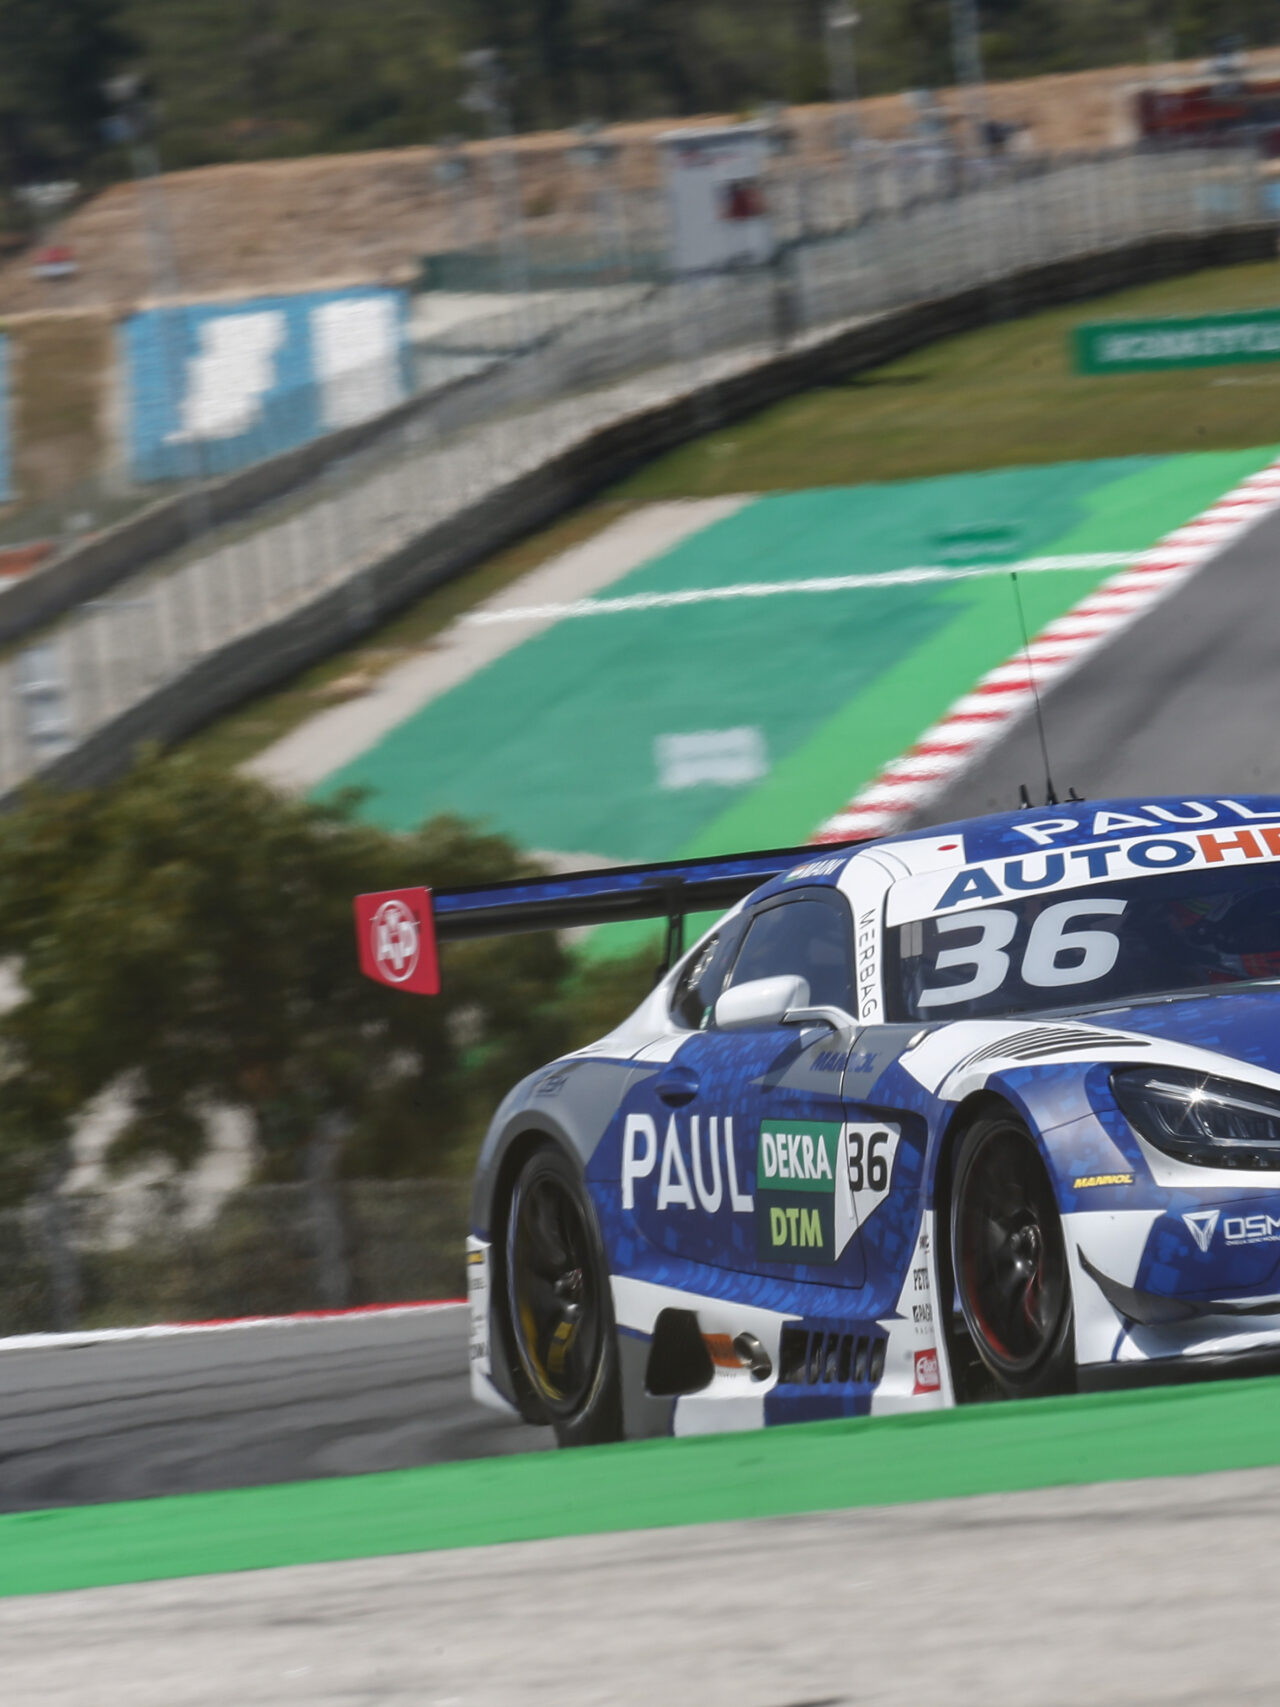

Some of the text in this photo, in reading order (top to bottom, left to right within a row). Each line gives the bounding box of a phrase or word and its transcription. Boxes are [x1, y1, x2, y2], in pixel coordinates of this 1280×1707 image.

[859, 908, 878, 1019] MERBAG
[917, 898, 1129, 1008] 36
[621, 1113, 754, 1213] PAUL
[761, 1132, 833, 1180] DEKRA
[848, 1132, 890, 1192] 36
[1073, 1174, 1133, 1189] MANNOL
[770, 1207, 823, 1248] DTM
